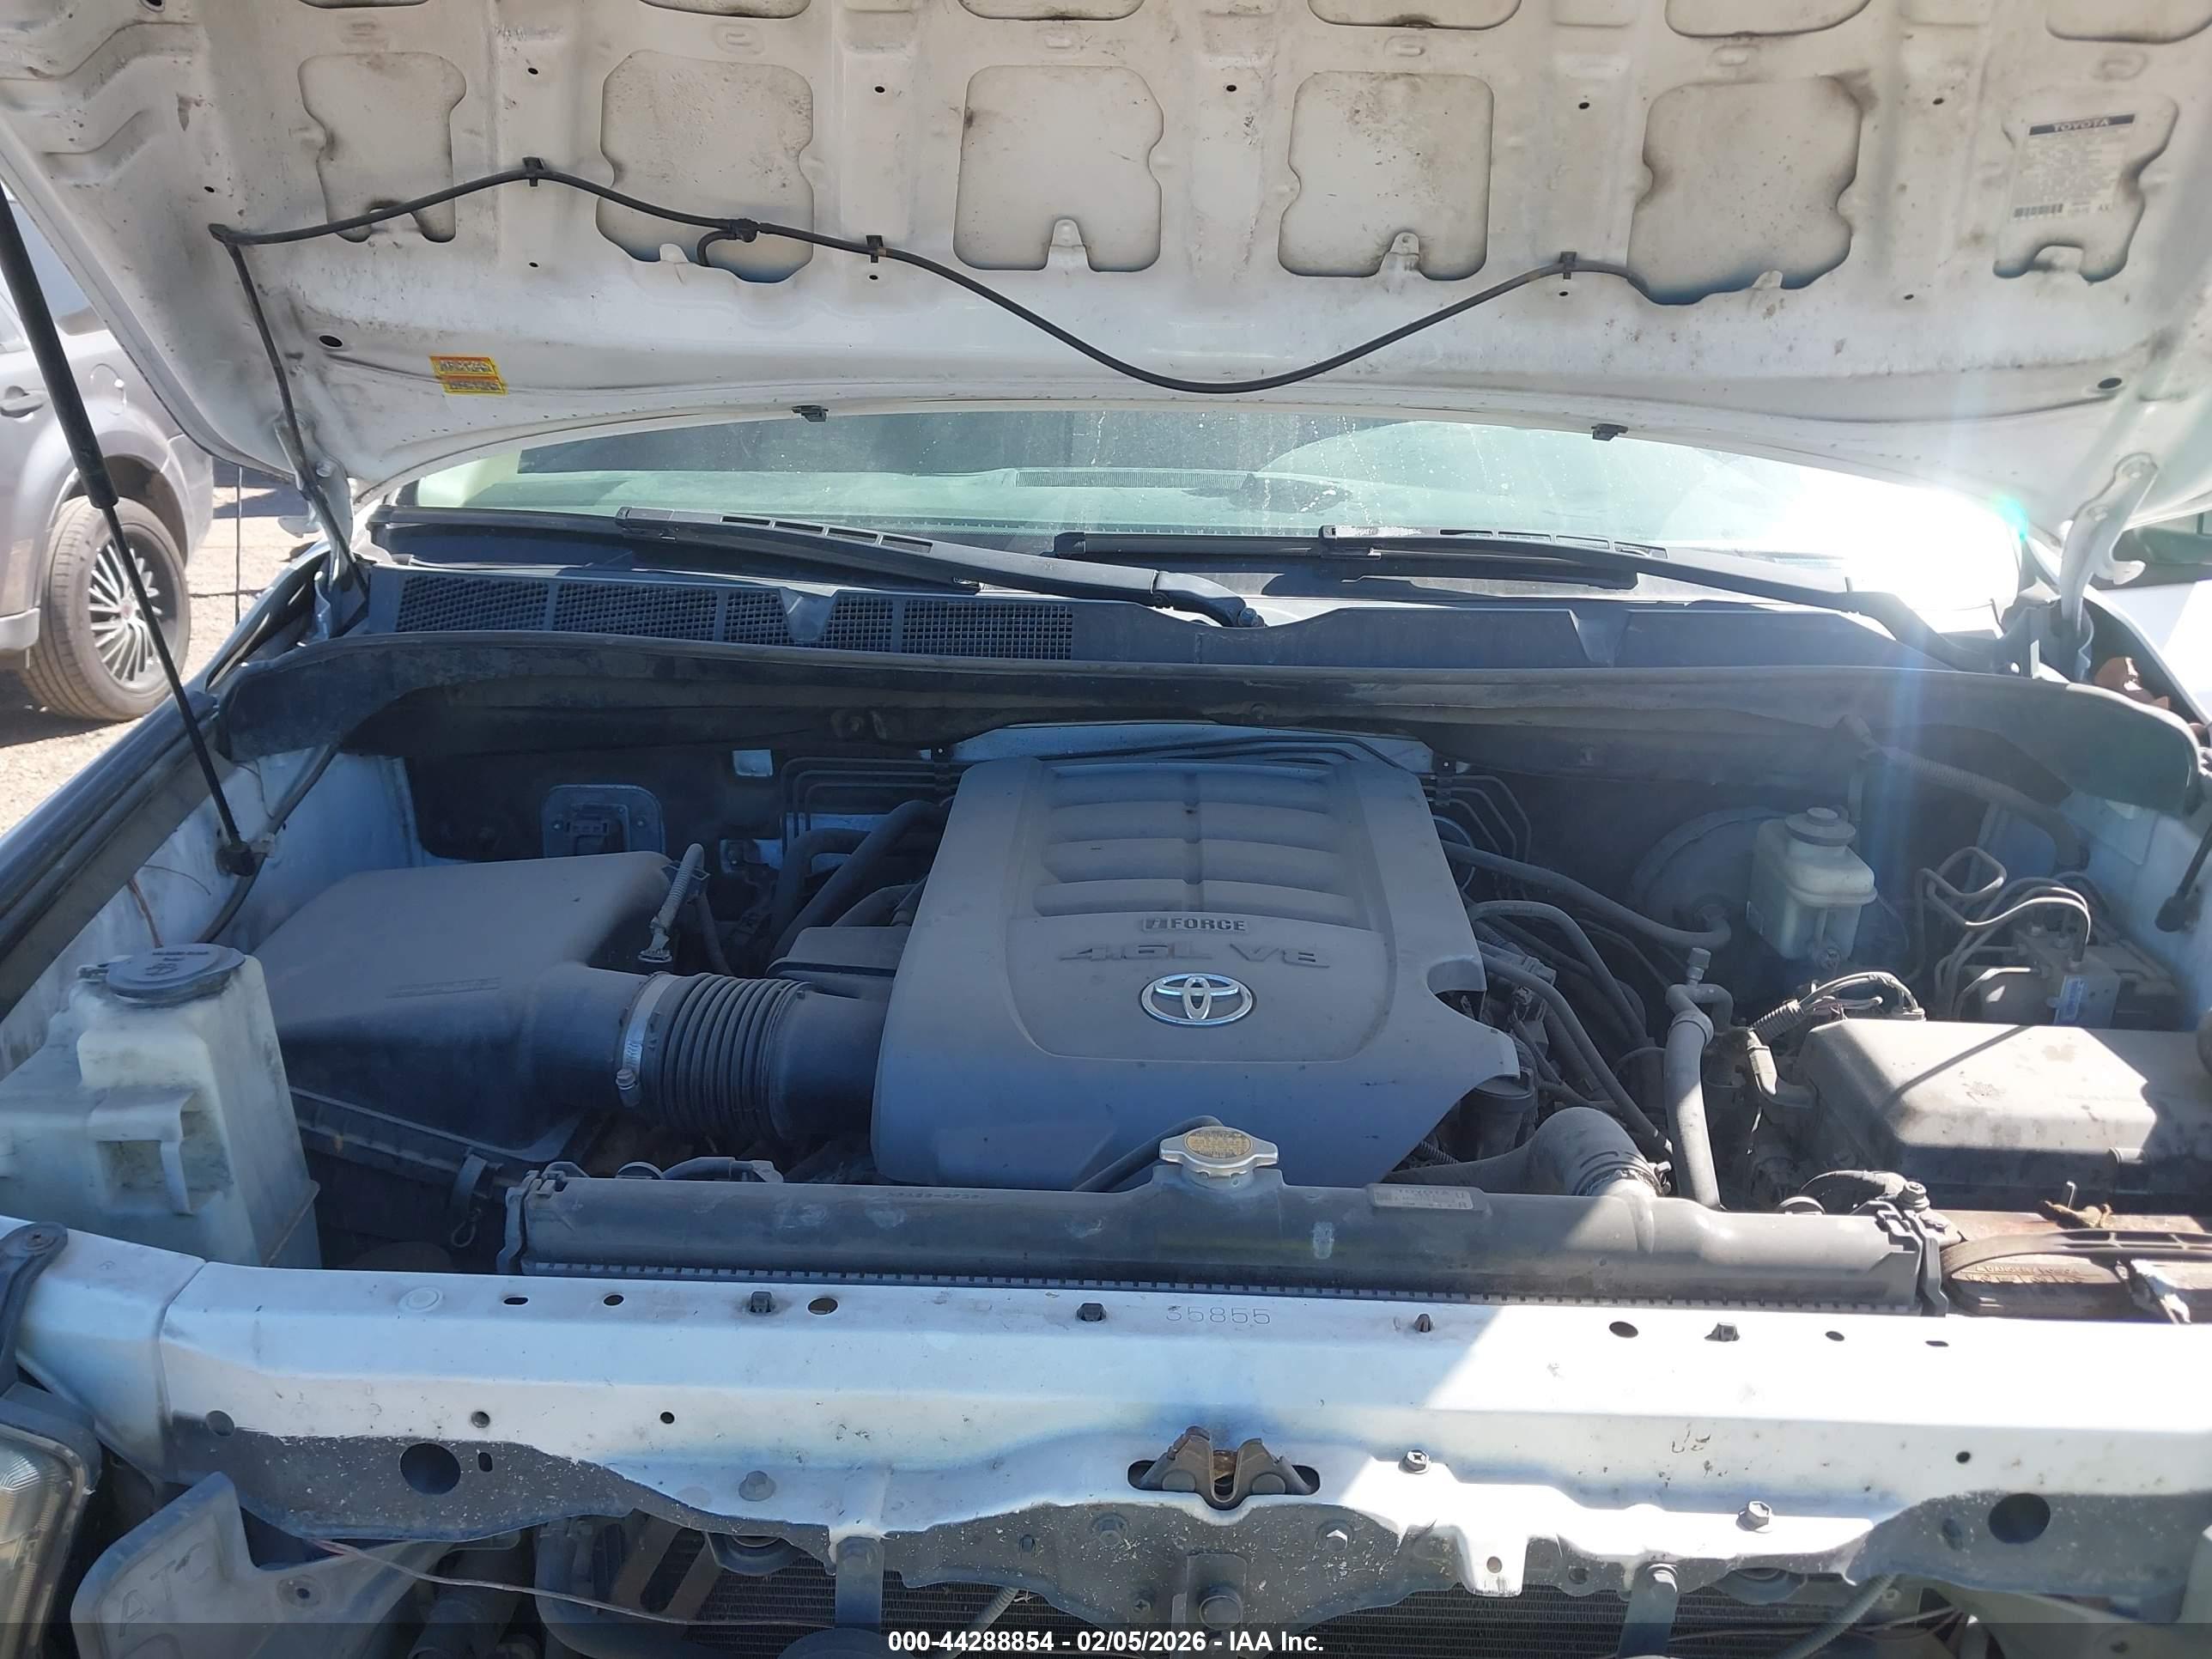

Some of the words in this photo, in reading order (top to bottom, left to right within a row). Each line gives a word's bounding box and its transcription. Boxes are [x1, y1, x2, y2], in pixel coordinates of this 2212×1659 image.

[2053, 118, 2110, 132] TOYOTA
[1229, 943, 1330, 969] V8
[1166, 1305, 1271, 1325] 35855
